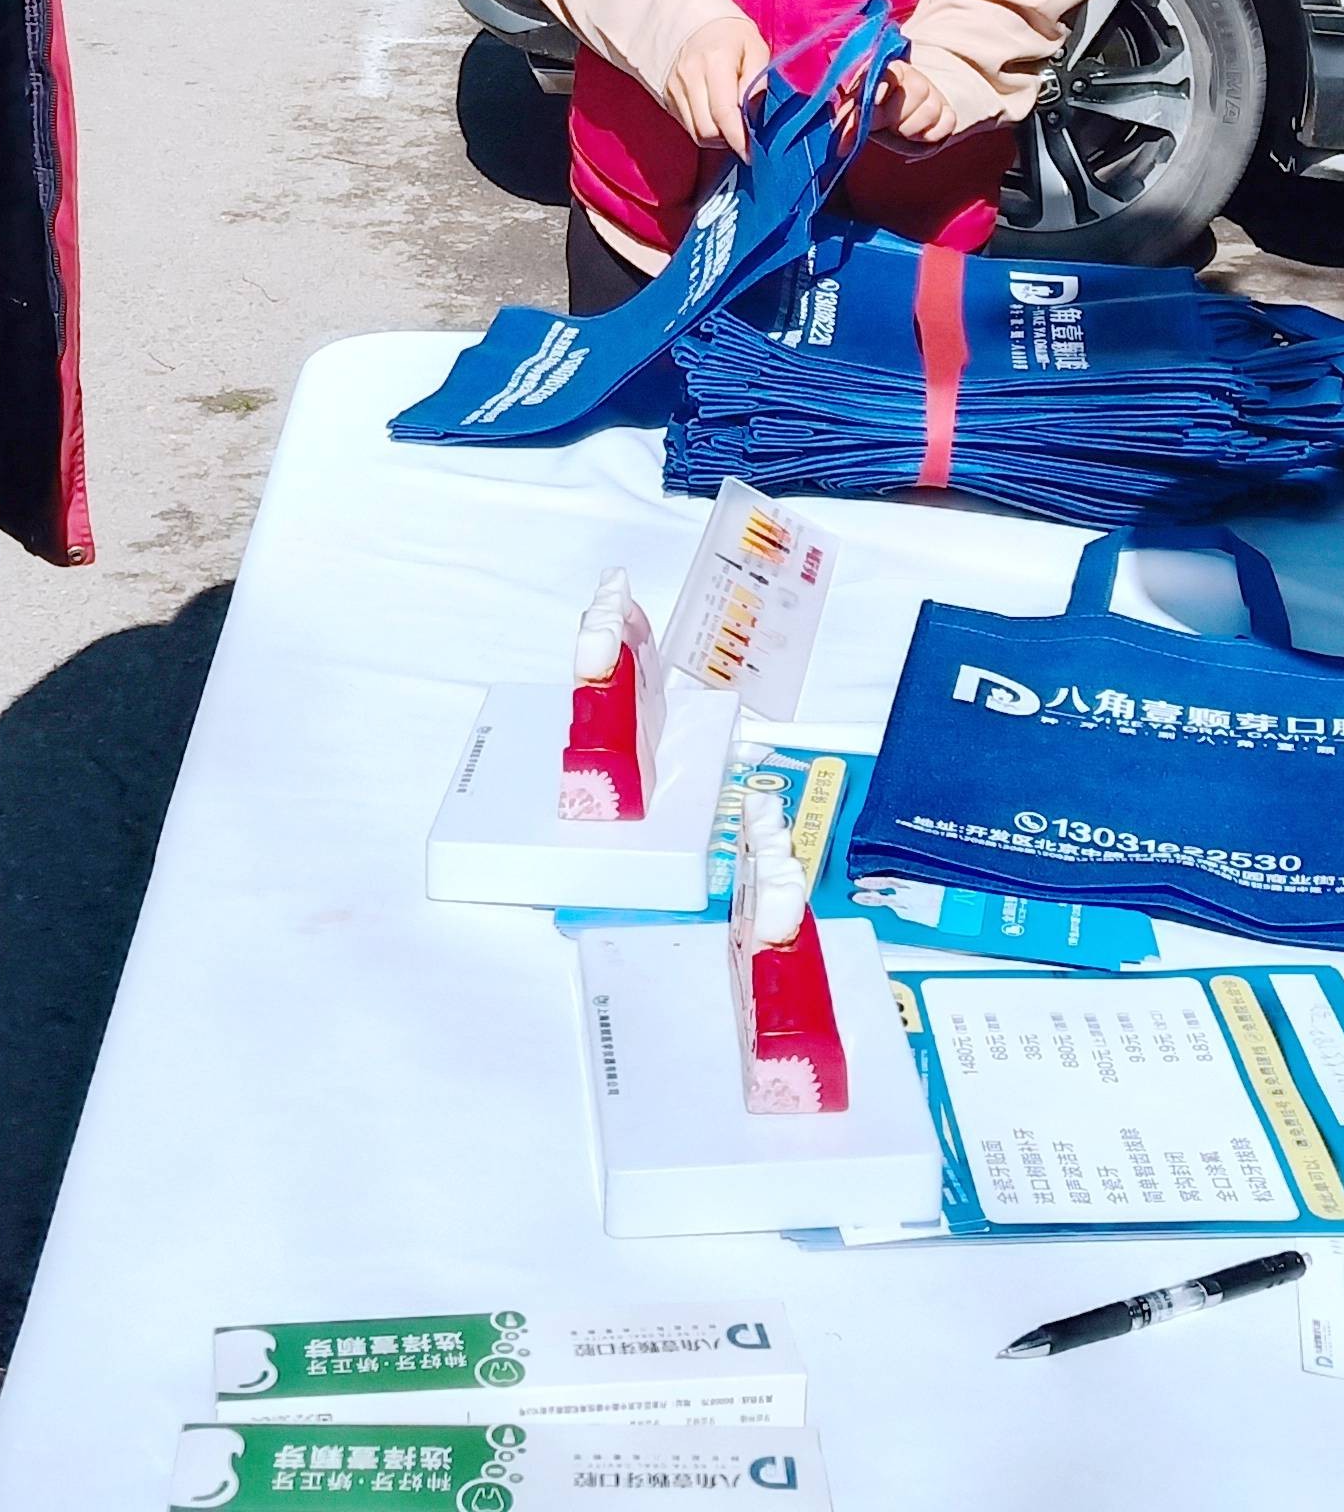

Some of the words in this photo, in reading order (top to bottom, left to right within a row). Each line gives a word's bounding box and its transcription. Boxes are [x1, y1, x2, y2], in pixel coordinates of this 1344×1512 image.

[1182, 726, 1242, 737] ORAL
[1247, 731, 1327, 743] CAVITY
[1019, 1034, 1042, 1061] 38元
[981, 1140, 1019, 1204] 全瓷牙贴面
[1013, 1128, 1056, 1205] 进口树脂补牙
[1052, 1140, 1093, 1205] 超声波洁牙
[1120, 1127, 1165, 1203] 简单智齿拔除
[1164, 1151, 1203, 1202] 窝沟封闭
[1230, 1137, 1275, 1202] 松动牙拔除
[1096, 1165, 1129, 1204] 全瓷牙
[303, 1331, 465, 1358] 选择壹颗芽
[574, 1336, 721, 1357] 八角壹颗芽口腔
[306, 1351, 467, 1375] 种好牙·矫正牙
[273, 1445, 452, 1471] 选择壹颗芽
[272, 1470, 452, 1493] 种好牙·矫正牙
[574, 1472, 741, 1489] 八角壹颗芽口腔
